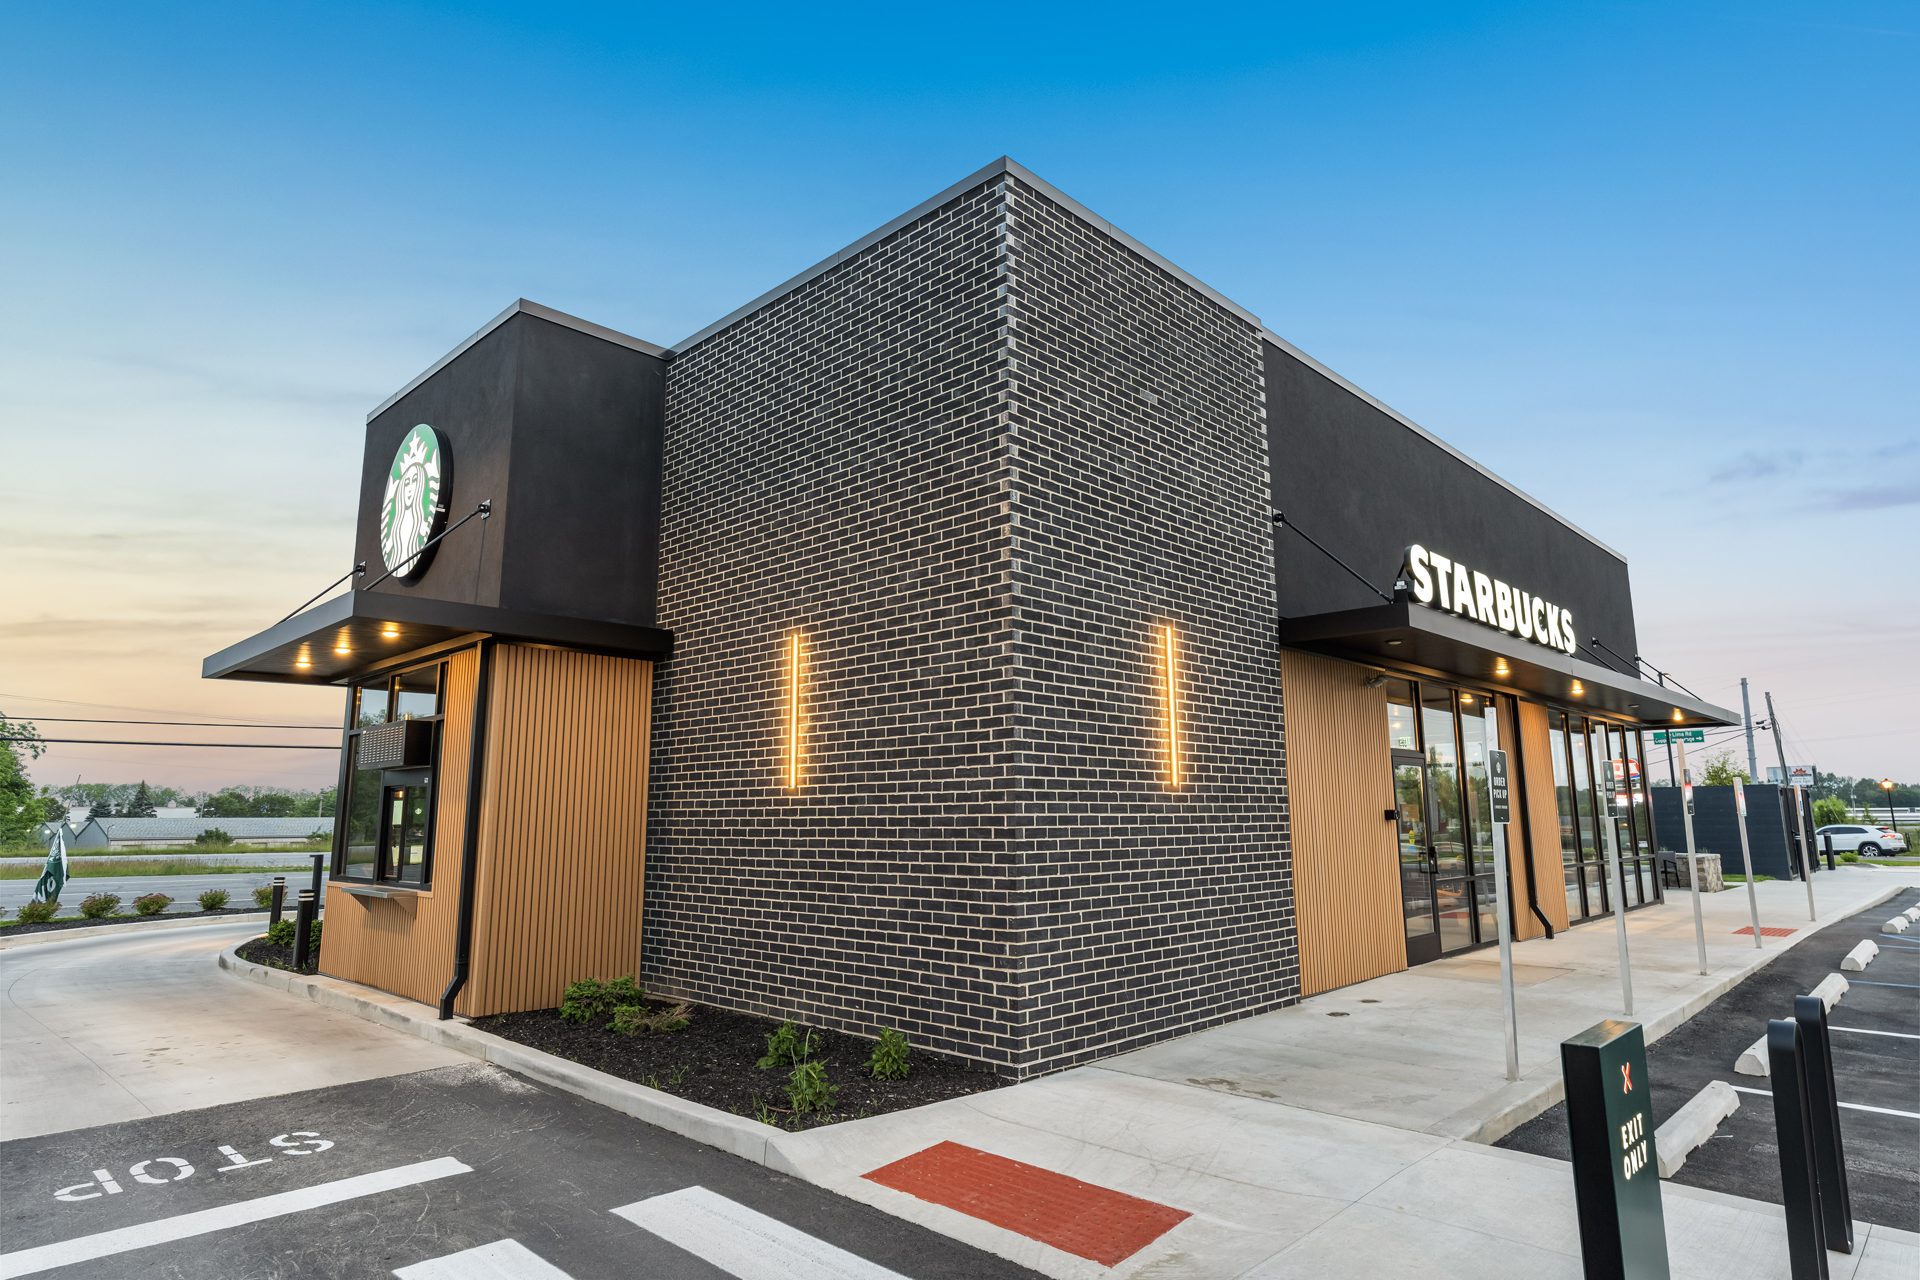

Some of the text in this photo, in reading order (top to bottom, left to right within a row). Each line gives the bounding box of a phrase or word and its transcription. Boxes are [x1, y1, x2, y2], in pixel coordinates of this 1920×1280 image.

[1409, 543, 1577, 654] STARBUCKS
[1493, 776, 1506, 787] ORDER
[1493, 788, 1507, 799] PICK UP
[1621, 1112, 1643, 1150] EXIT
[53, 1131, 335, 1202] STOP
[1623, 1139, 1648, 1180] ONLY
